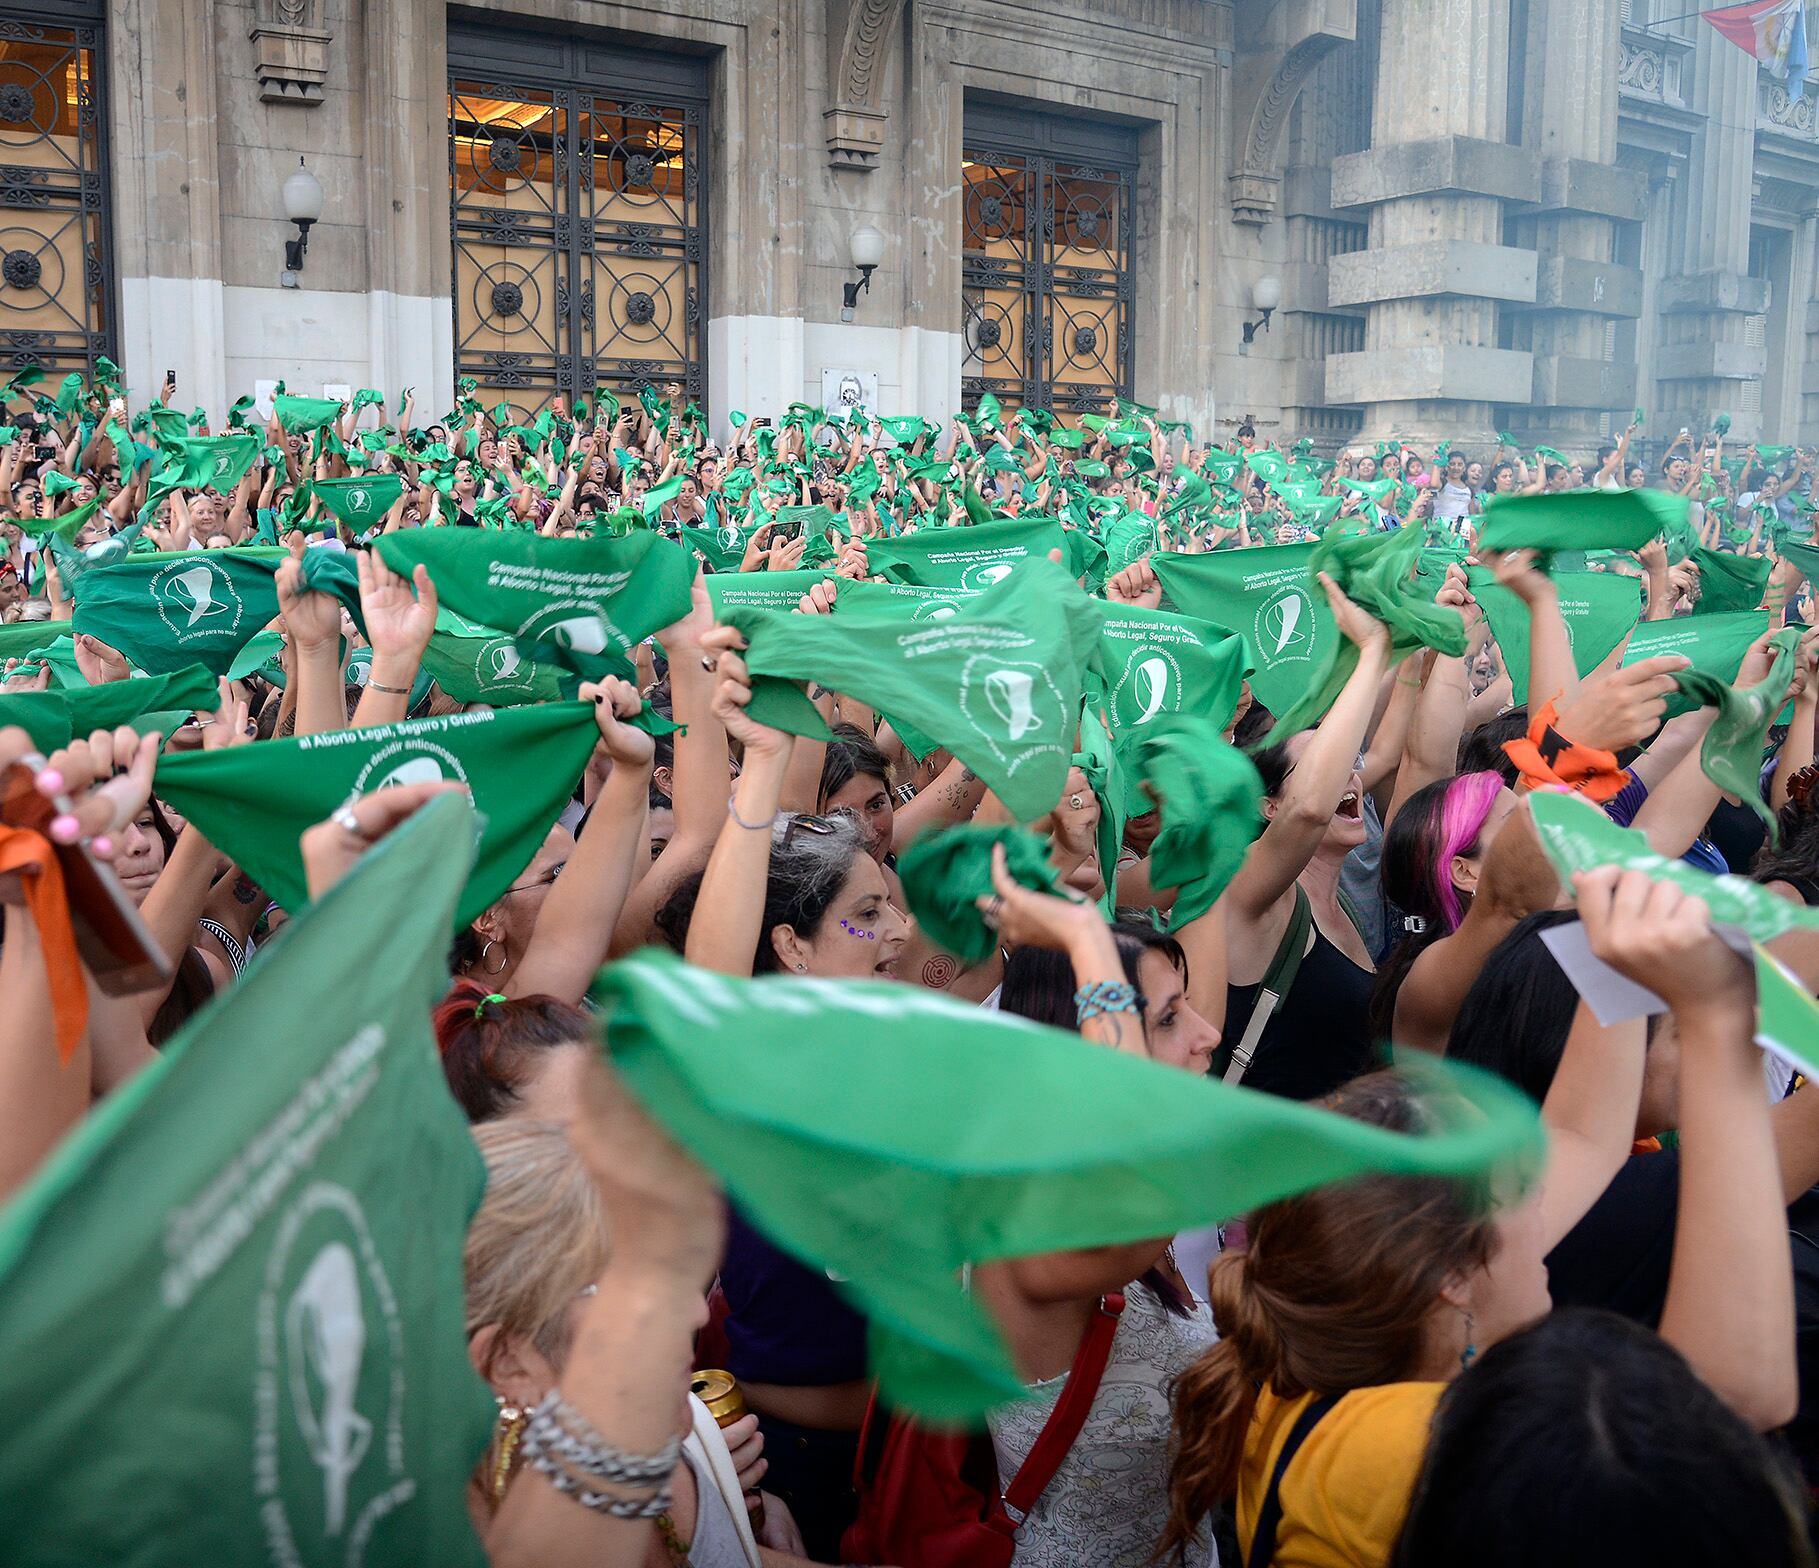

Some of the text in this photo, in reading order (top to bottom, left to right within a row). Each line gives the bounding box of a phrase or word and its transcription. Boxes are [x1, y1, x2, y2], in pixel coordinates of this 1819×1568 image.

[164, 558, 185, 572] decidir
[151, 570, 164, 586] para
[1250, 580, 1268, 590] Aborto
[896, 587, 915, 596] Aborto
[916, 590, 932, 599] Legal,
[747, 598, 763, 606] Legal,
[158, 601, 181, 636] Educación
[232, 603, 243, 630] abortar
[1104, 620, 1128, 629] mpaña
[1129, 620, 1158, 630] Nacional
[1160, 623, 1170, 631] Por
[1127, 631, 1147, 641] Legal,
[1149, 632, 1174, 642] Seguro
[1176, 636, 1180, 644] y
[1110, 690, 1120, 728] Educación
[1115, 668, 1130, 691] sexual
[1149, 645, 1182, 684] anticonceptivos
[1175, 701, 1180, 712] no
[298, 710, 495, 750] al Aborto Legal, Seguro y Gratuito
[355, 738, 468, 790] para decidir anticonceptivos
